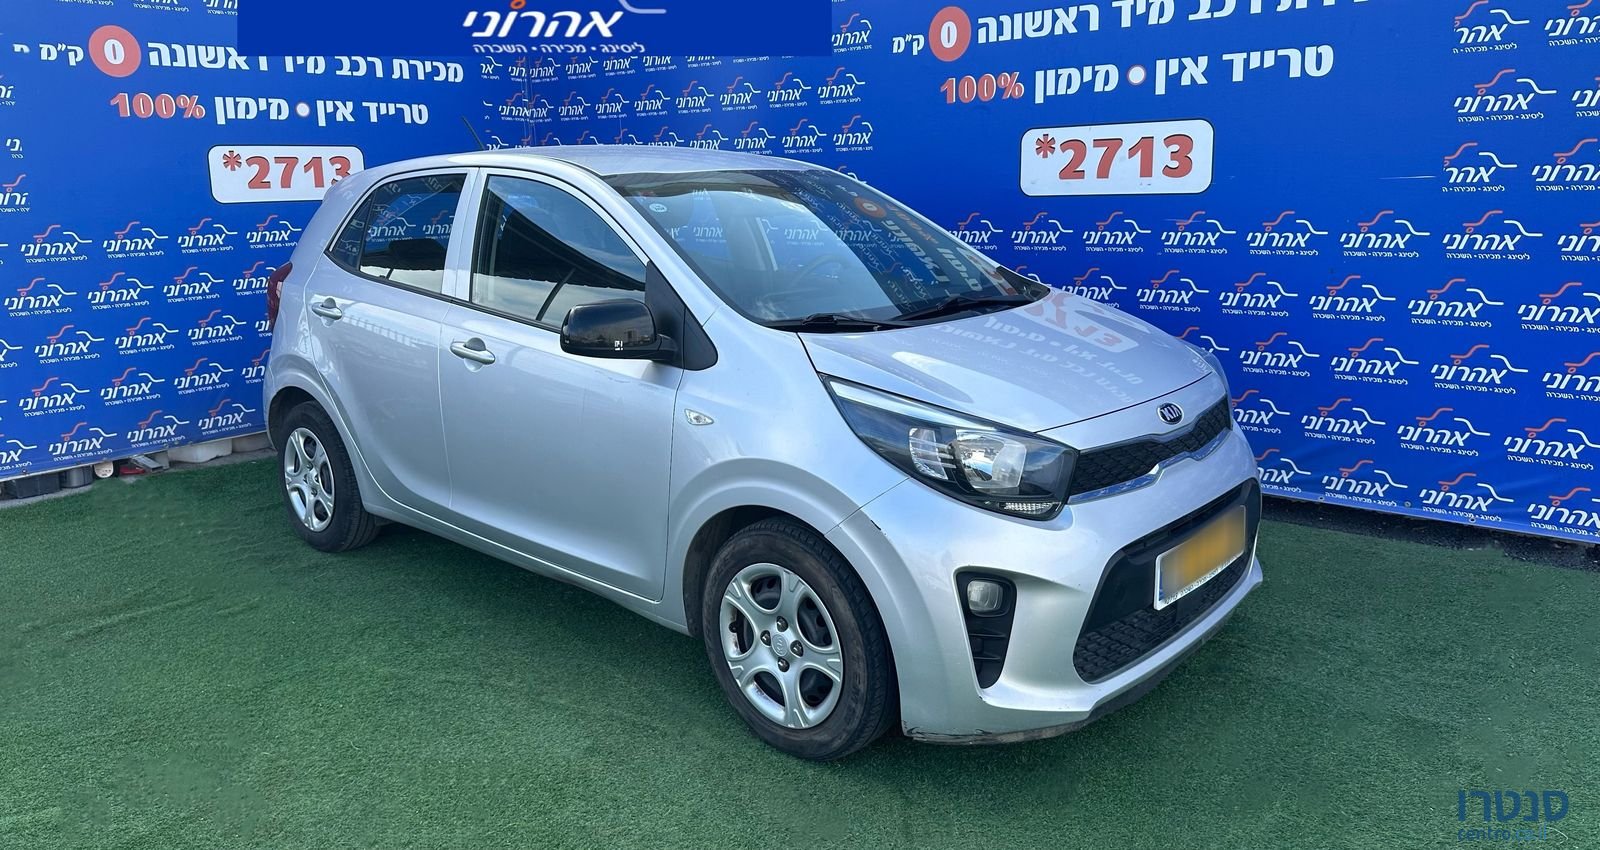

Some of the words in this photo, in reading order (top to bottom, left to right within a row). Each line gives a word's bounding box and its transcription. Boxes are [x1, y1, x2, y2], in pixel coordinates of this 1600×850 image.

[977, 4, 1100, 43] ראשונה
[1112, 0, 1175, 28] מיד
[940, 21, 957, 48] 0
[104, 39, 125, 65] 0
[335, 56, 383, 78] רכב
[392, 58, 464, 83] מכירת
[1222, 44, 1334, 82] טרייד
[1034, 63, 1119, 104] מימון
[1155, 56, 1208, 95] אין
[940, 71, 1025, 104] 100%
[110, 92, 206, 119] 100%
[215, 96, 290, 125] מימון
[316, 100, 355, 127] אין
[362, 101, 429, 125] טרייד
[1454, 93, 1534, 113] אהרוני
[1011, 231, 1060, 244] אהרוני
[1083, 231, 1136, 245] אהרוני
[1161, 231, 1220, 246] אהרוני
[1247, 232, 1310, 247] אהרוני
[1340, 233, 1411, 249] אהרוני
[1442, 234, 1521, 250] אהרוני
[1137, 288, 1193, 303] אהרוני
[1219, 292, 1281, 308] אהרוני
[1309, 296, 1377, 312] אהרוני
[1408, 300, 1483, 318] אהרוני
[1240, 351, 1302, 368] אהרוני
[1331, 357, 1400, 376] אהרוני
[1431, 364, 1507, 384] אהרוני
[1160, 405, 1181, 421] KIA
[1301, 415, 1367, 435] אהרוני
[1396, 425, 1470, 446] אהרוני
[1504, 436, 1585, 459] אהרוני
[1322, 475, 1389, 497] אהרוני
[1419, 489, 1493, 512] אהרוני
